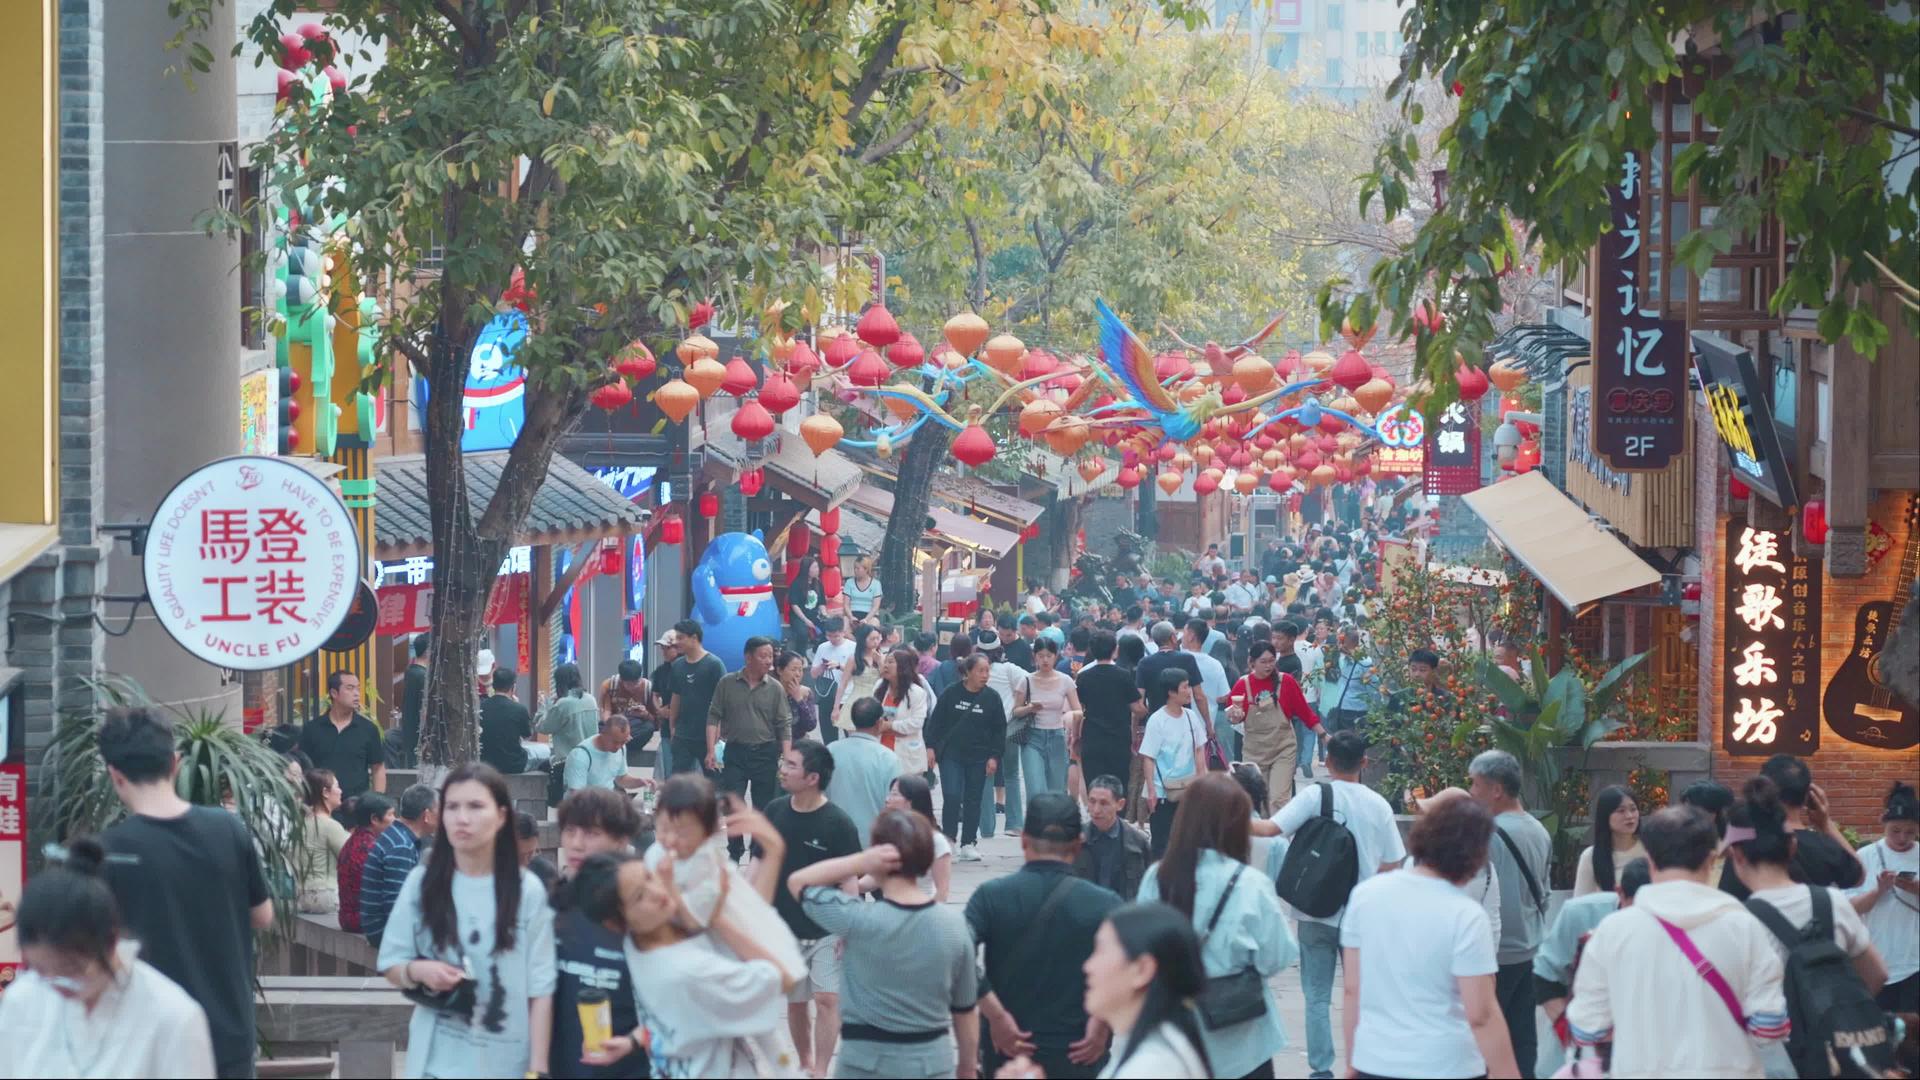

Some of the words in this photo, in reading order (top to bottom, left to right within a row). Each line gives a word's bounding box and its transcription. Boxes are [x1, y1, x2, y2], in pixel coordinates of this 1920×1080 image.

[1437, 401, 1465, 453] 火锅
[1625, 436, 1655, 456] 2F
[167, 480, 215, 529] DOESN'T
[281, 478, 317, 509] HAVE
[200, 508, 307, 564] 馬登
[317, 507, 334, 528] TO
[159, 530, 175, 557] LIFE
[328, 531, 343, 549] BE
[157, 563, 185, 619] QUALITY
[201, 569, 308, 624] 工装
[310, 554, 345, 631] EXPENSIVE
[184, 620, 197, 631] A
[204, 632, 270, 657] UNCLE
[275, 632, 301, 652] FU
[1732, 526, 1786, 744] 徒歌乐坊
